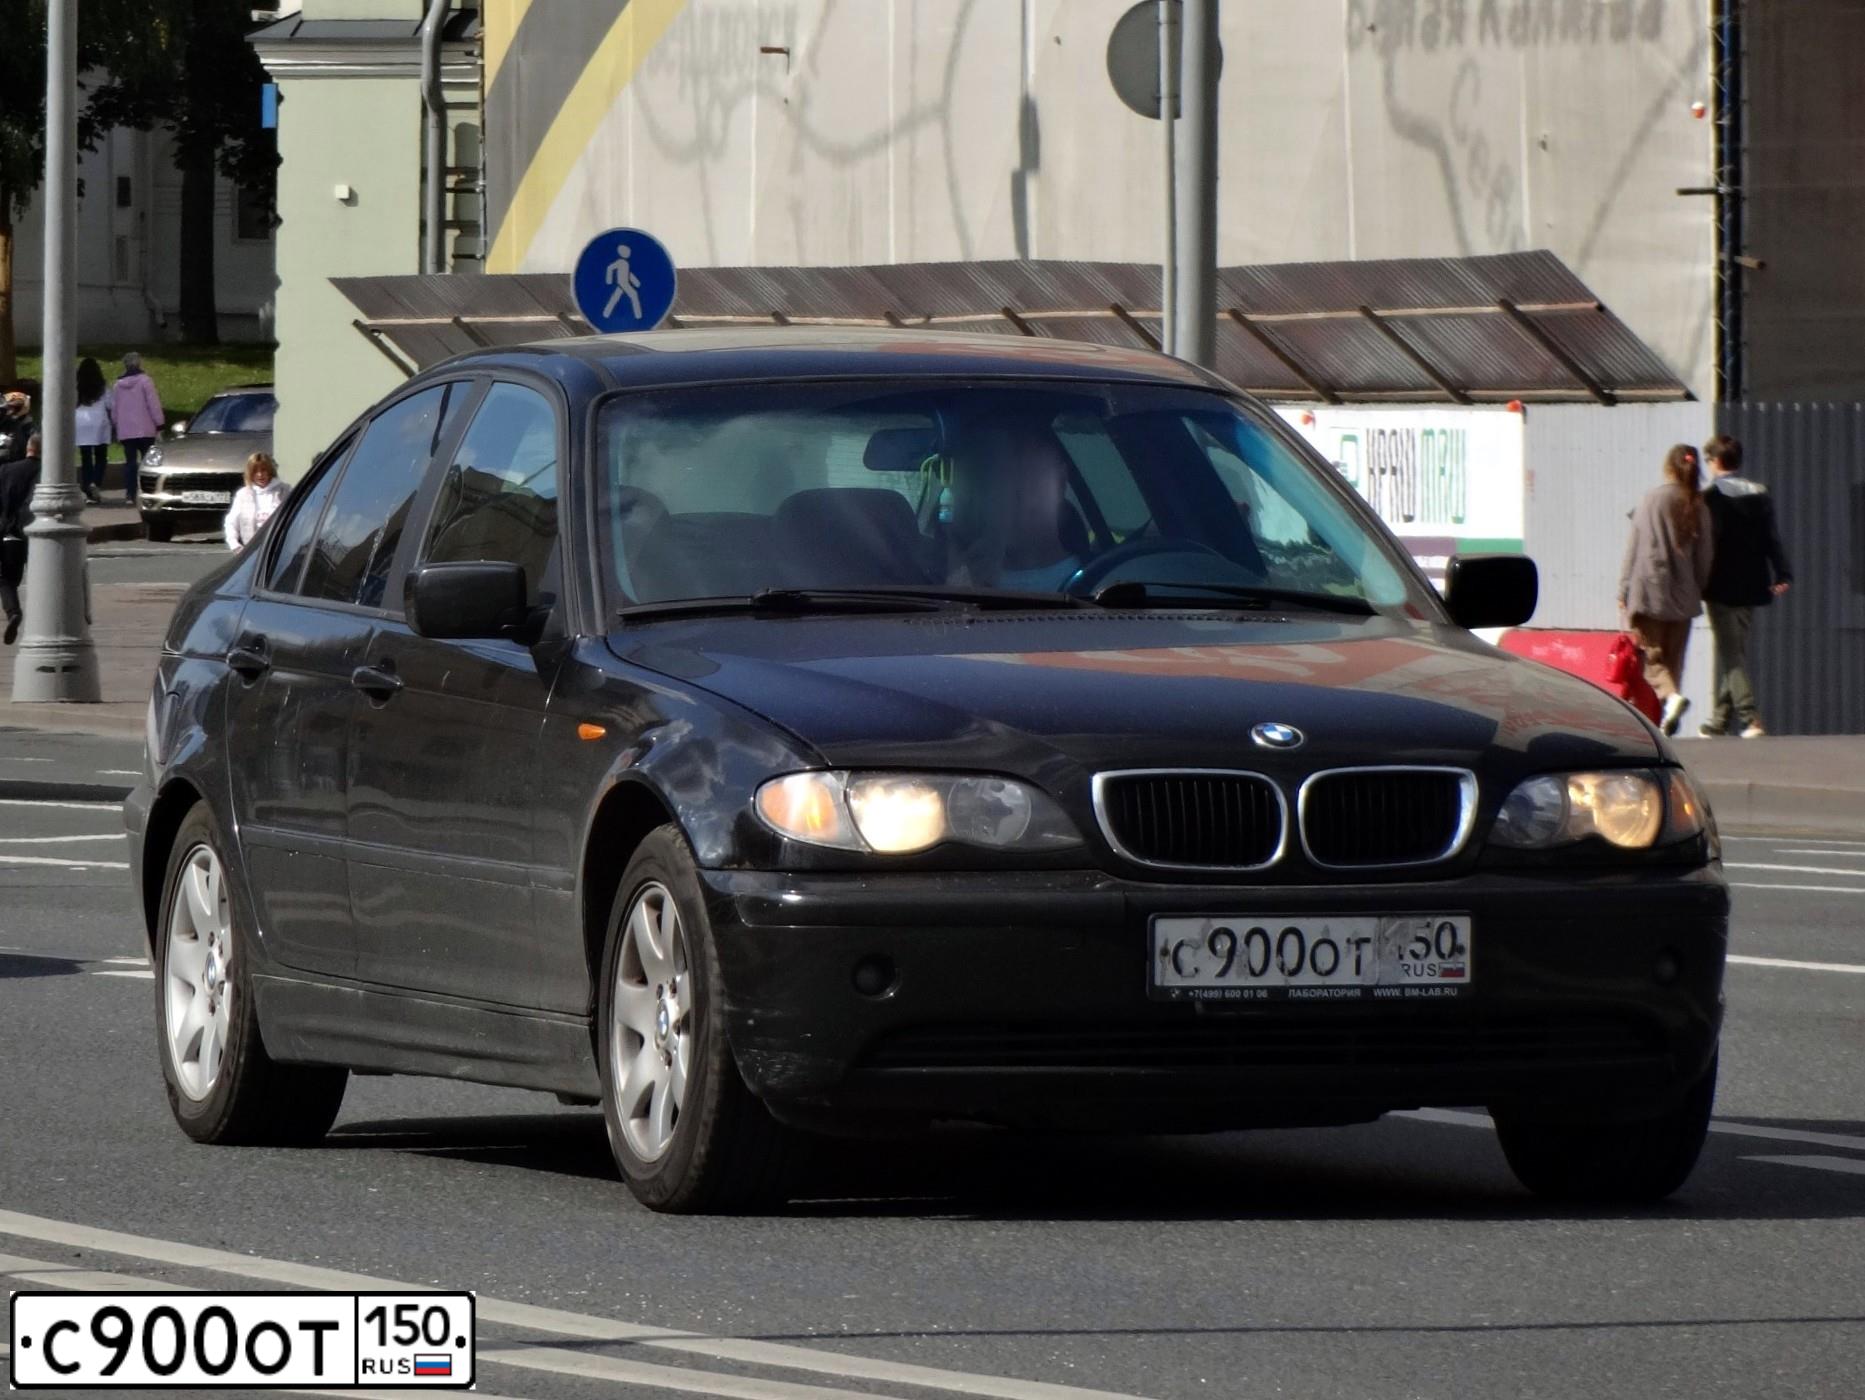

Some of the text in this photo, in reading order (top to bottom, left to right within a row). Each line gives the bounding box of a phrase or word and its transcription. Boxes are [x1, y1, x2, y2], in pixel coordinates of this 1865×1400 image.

[1172, 926, 1371, 978] С900ОТ
[1401, 963, 1437, 977] RUS
[1288, 988, 1361, 998] ЛАБОРАТОРИЯ
